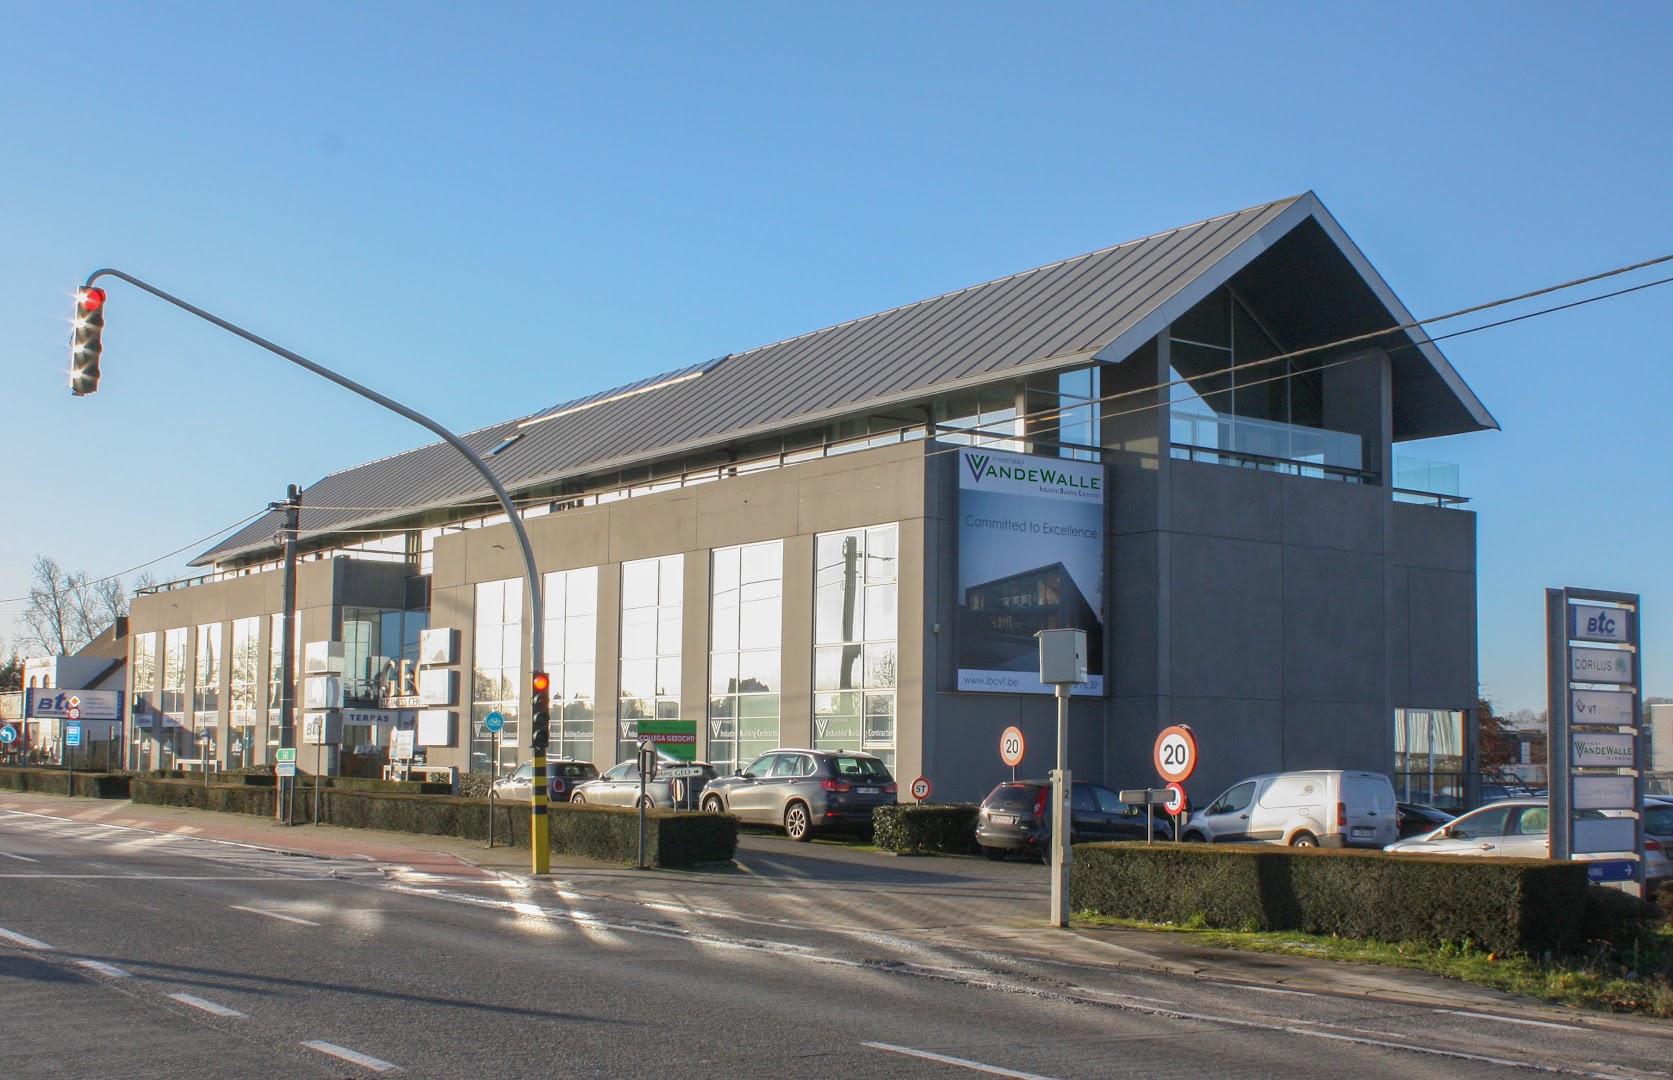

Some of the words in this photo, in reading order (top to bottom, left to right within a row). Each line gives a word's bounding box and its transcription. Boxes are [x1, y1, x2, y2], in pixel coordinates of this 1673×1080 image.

[965, 514, 1027, 532] Committed
[1029, 521, 1041, 533] to
[1043, 522, 1098, 540] Excellence
[1574, 658, 1613, 671] CORILUS
[963, 676, 1019, 687] www.ibcvt.be
[1089, 680, 1098, 690] 39
[349, 714, 390, 723] TERRAS
[1005, 739, 1019, 754] 20
[1164, 744, 1186, 766] 20
[674, 769, 691, 777] GEO
[1064, 789, 1070, 799] 2
